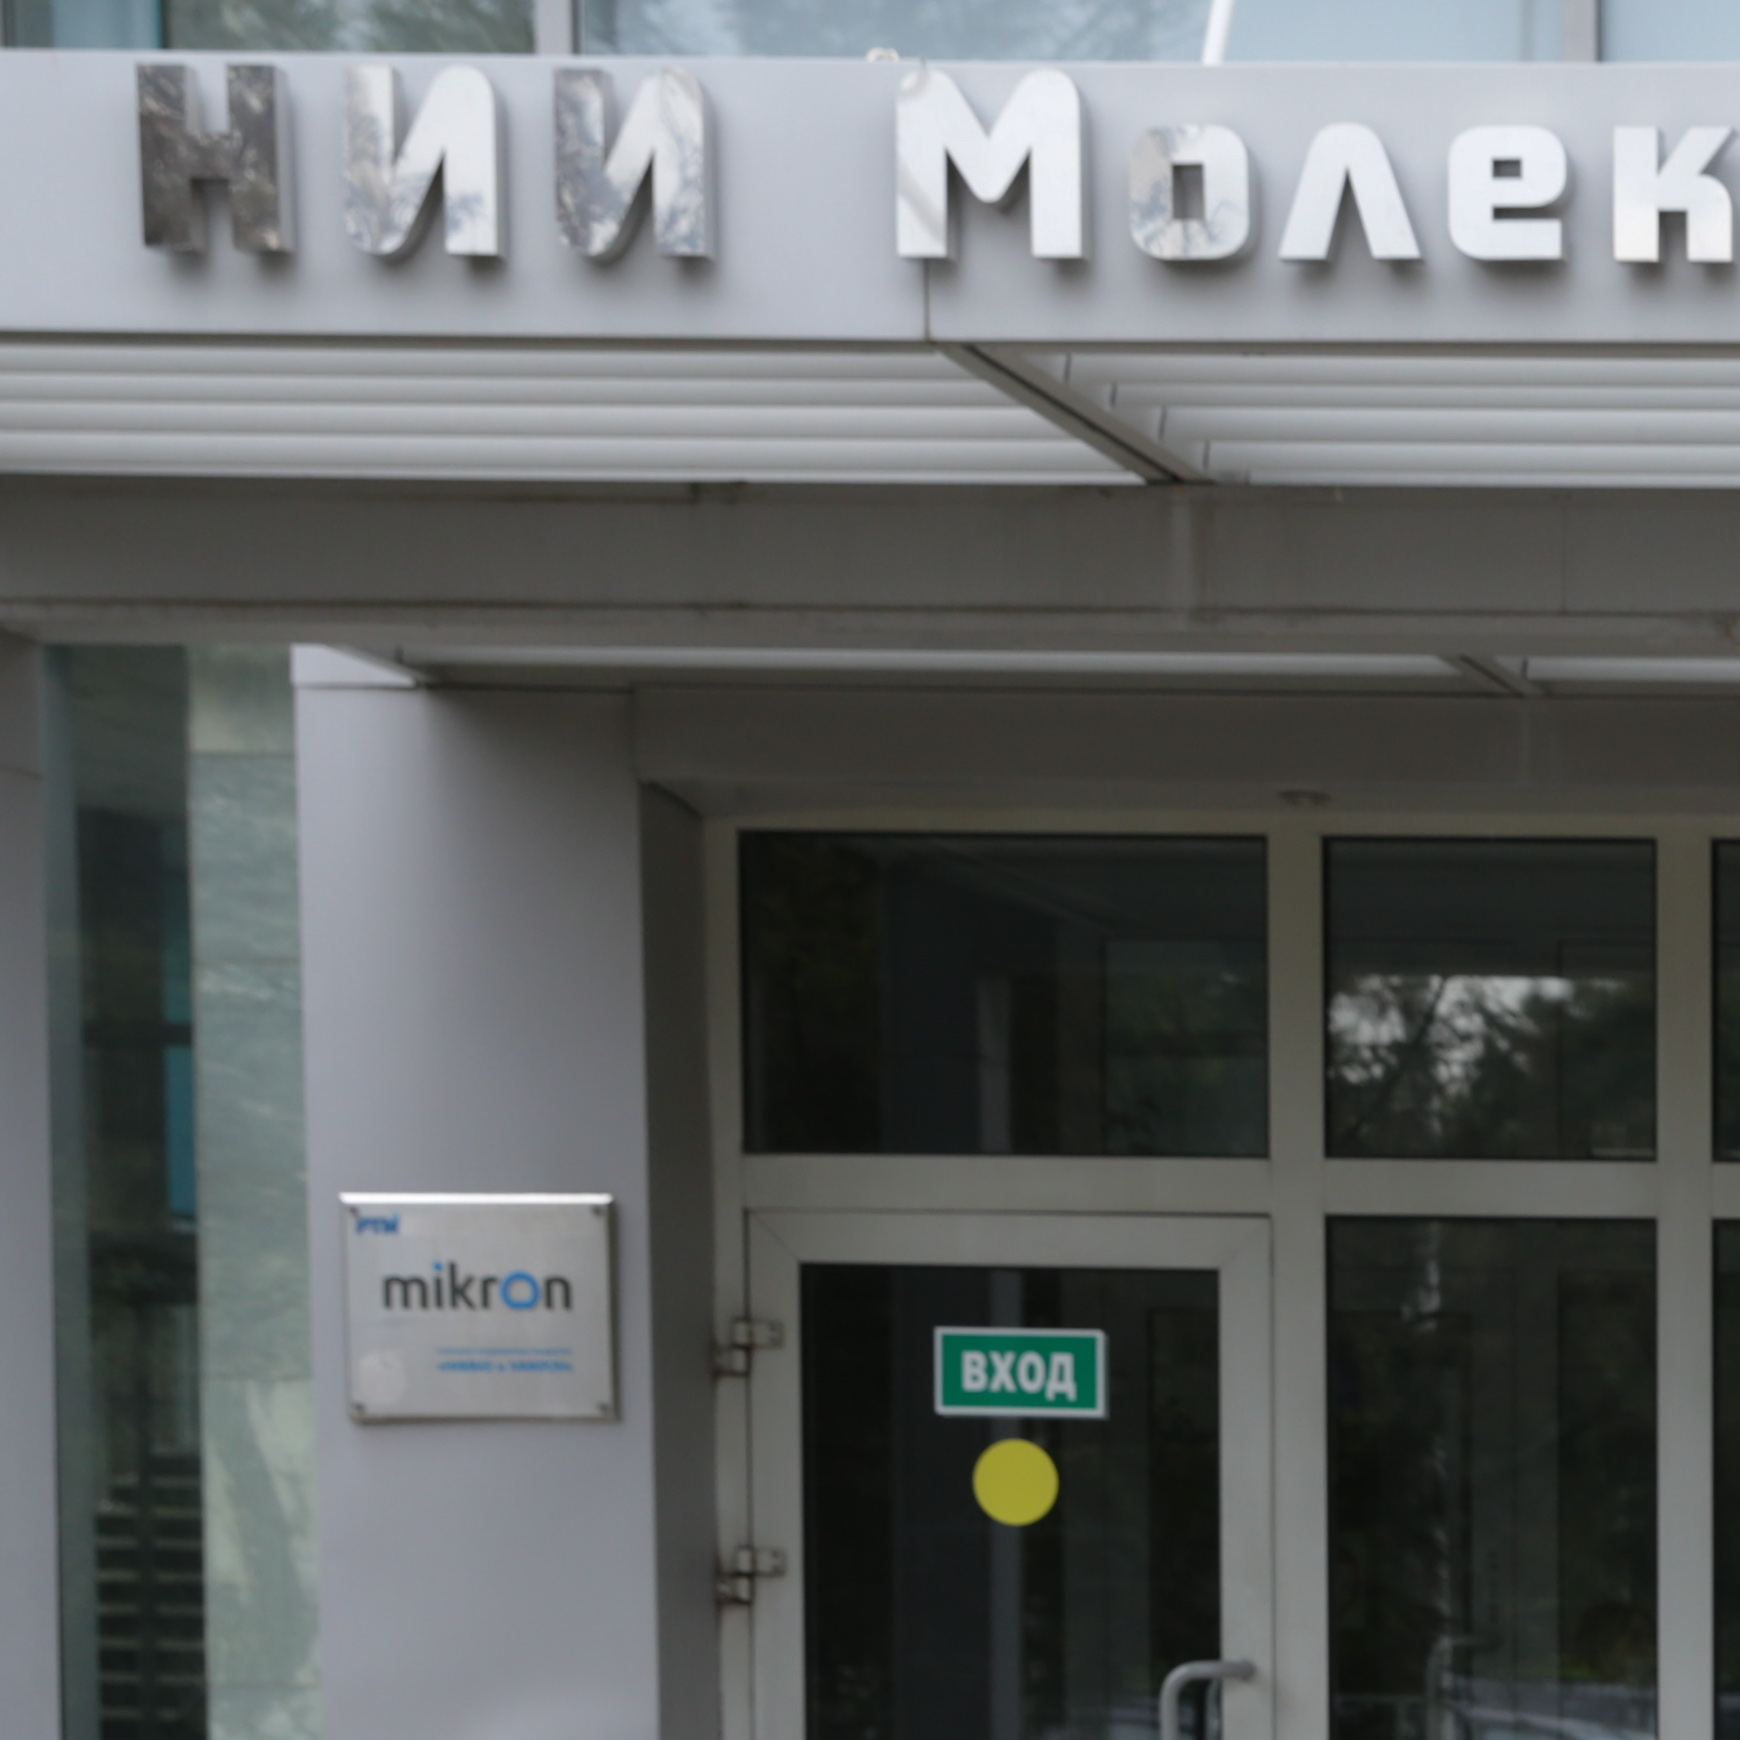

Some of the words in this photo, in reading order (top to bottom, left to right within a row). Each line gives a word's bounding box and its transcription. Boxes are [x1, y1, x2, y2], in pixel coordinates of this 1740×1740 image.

[136, 64, 716, 262] НИИ
[383, 1261, 572, 1310] mikron
[960, 1350, 1078, 1402] ВХОД
